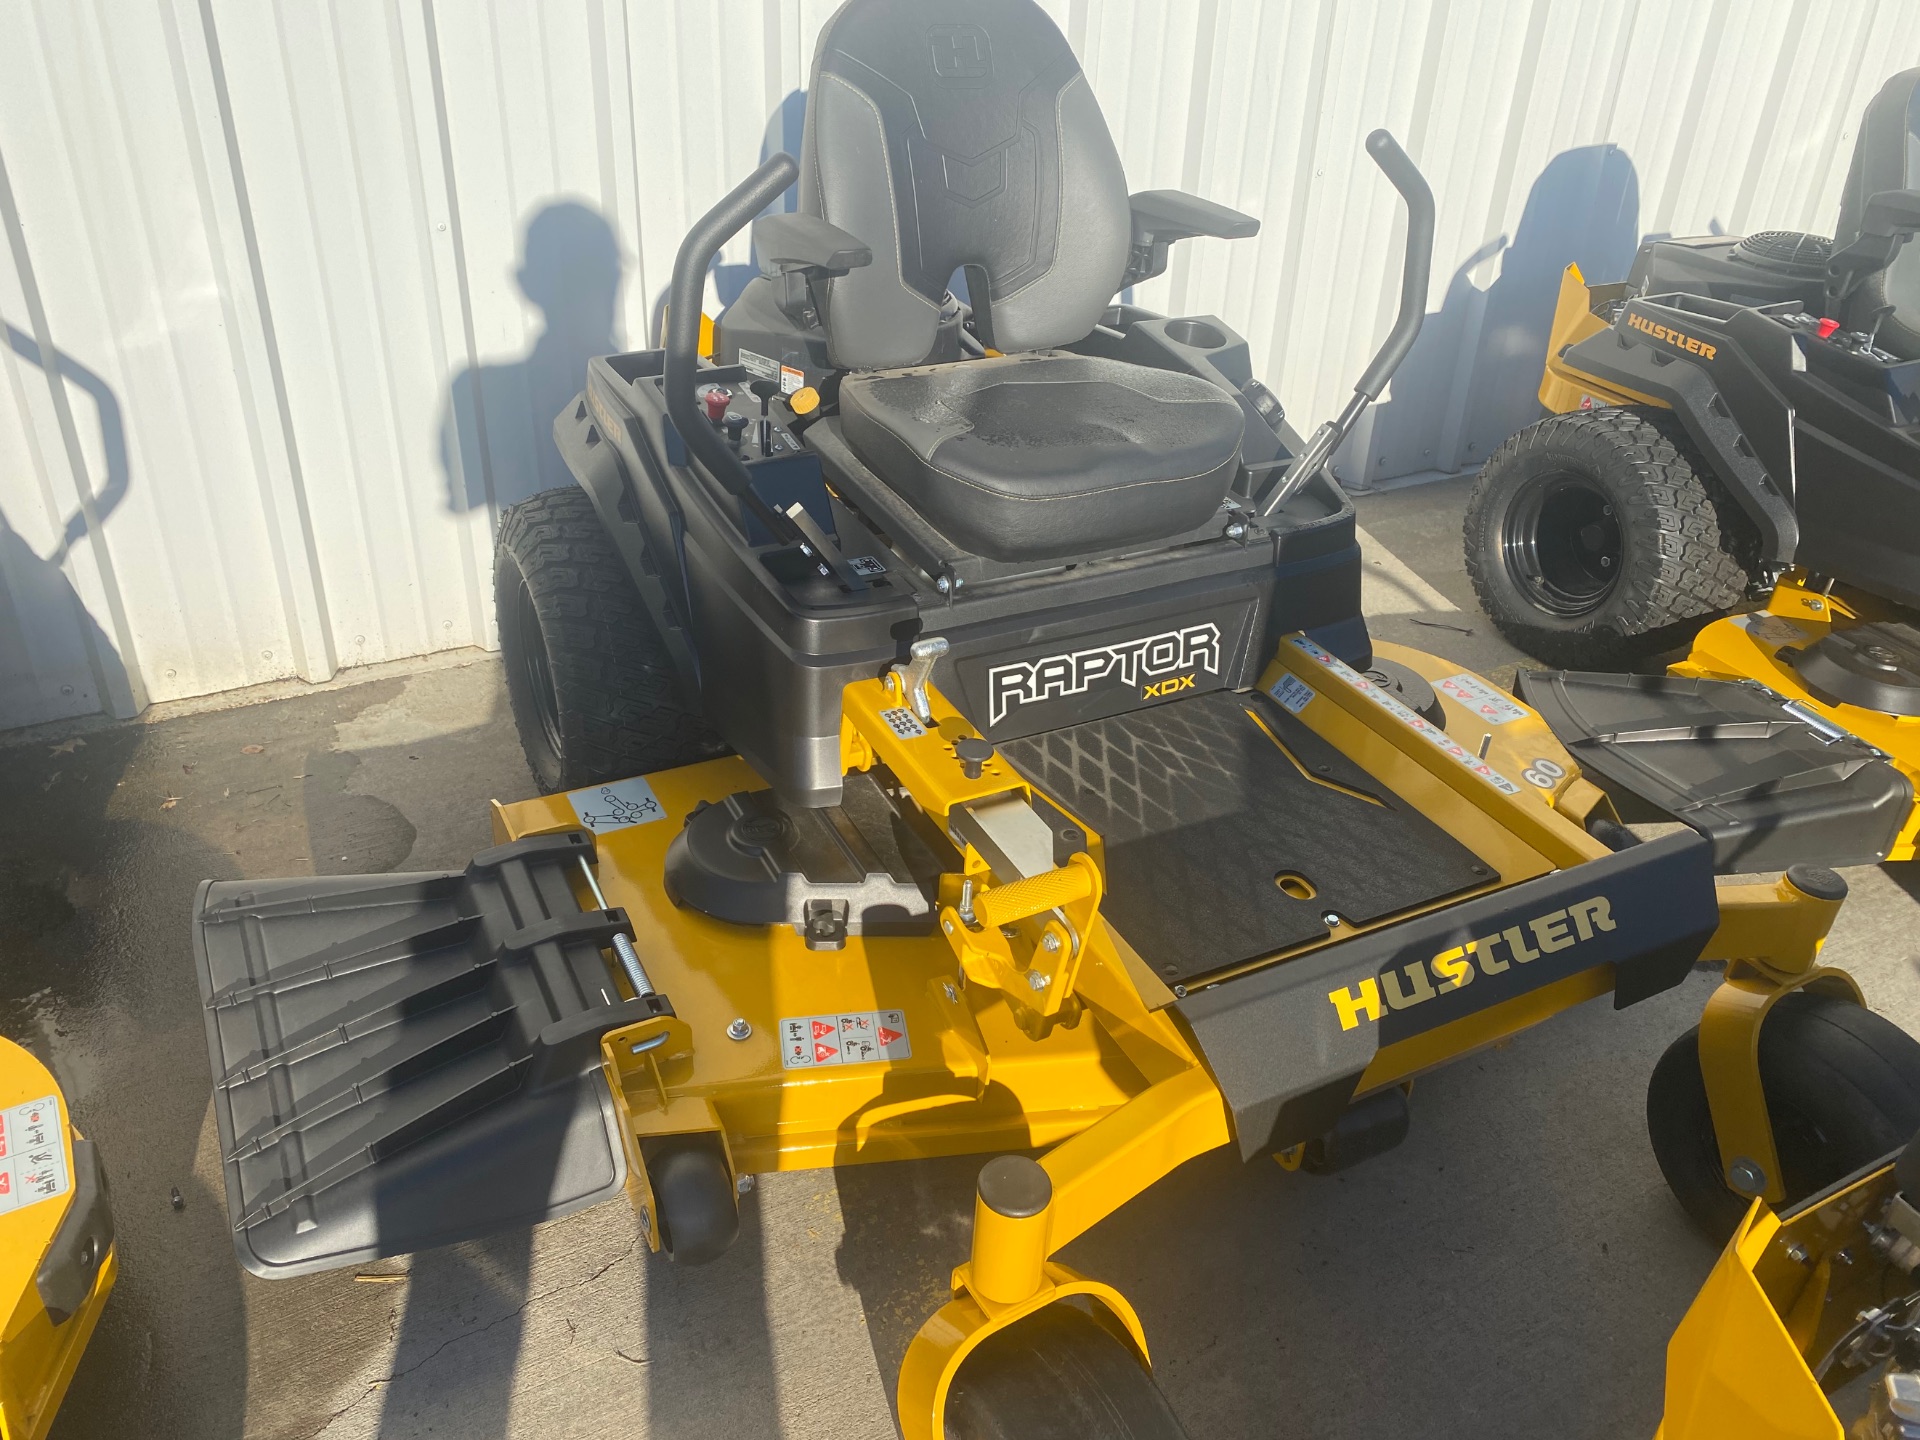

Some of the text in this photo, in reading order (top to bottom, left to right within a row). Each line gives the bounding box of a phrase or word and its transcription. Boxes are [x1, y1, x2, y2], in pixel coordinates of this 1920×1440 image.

[1627, 312, 1717, 361] HUSTLER
[988, 622, 1221, 727] RAPTOR
[1143, 673, 1196, 700] XDX
[1523, 759, 1564, 788] 60
[1328, 895, 1617, 1031] HUSTLER
